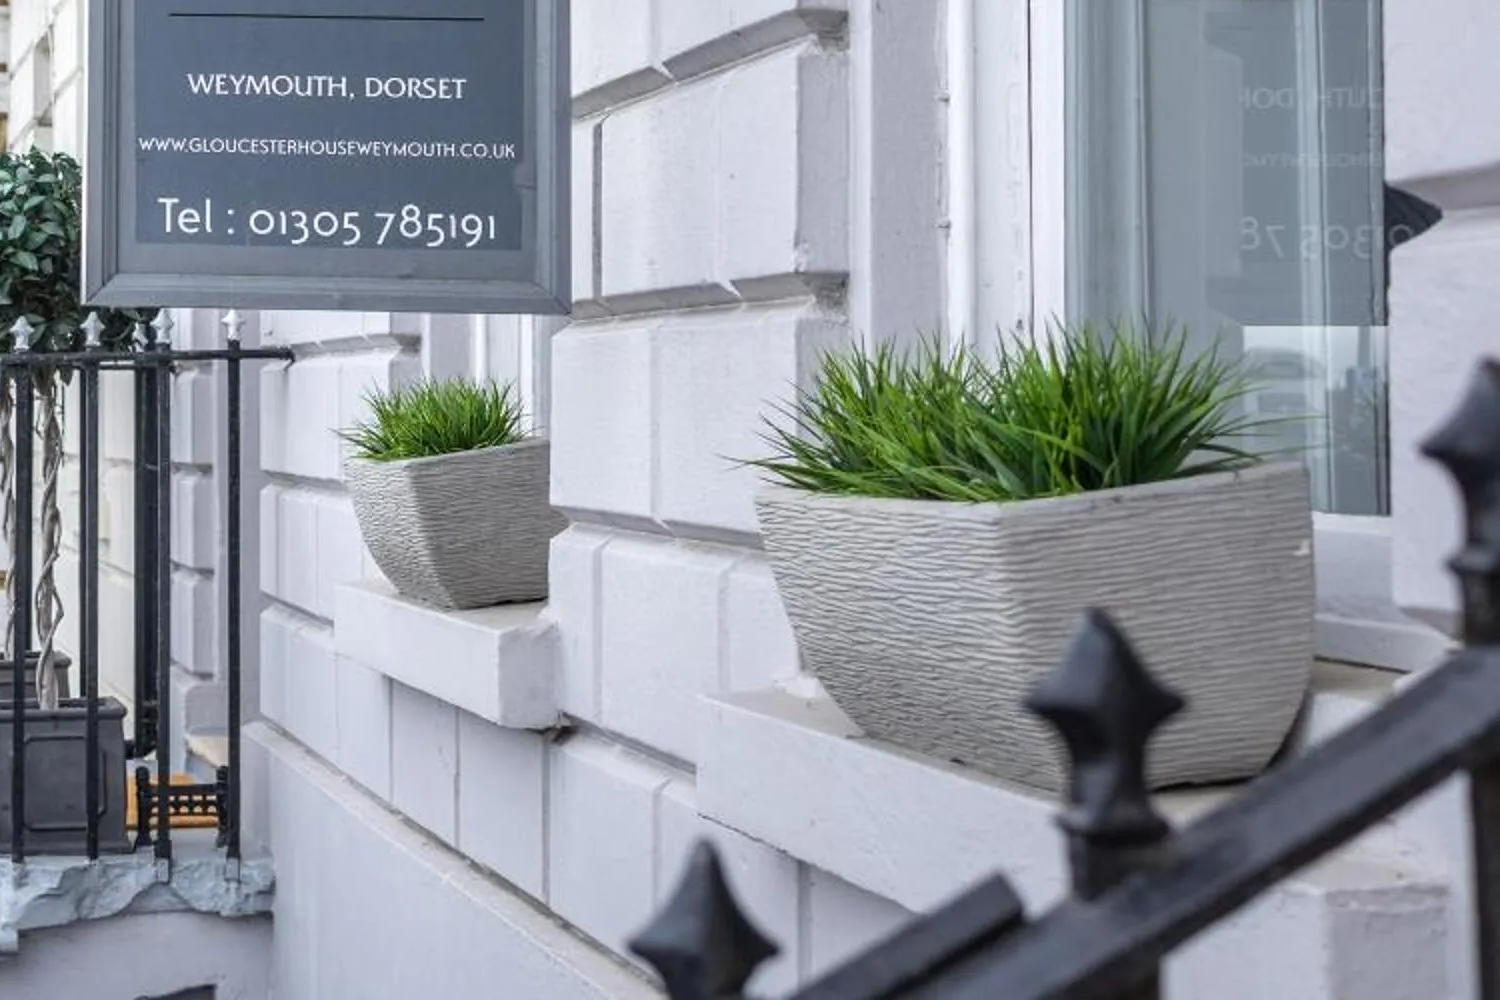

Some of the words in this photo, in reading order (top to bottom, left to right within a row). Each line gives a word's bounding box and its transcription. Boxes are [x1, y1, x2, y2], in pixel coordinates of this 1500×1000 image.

[365, 77, 467, 99] DORSET
[138, 137, 516, 159] WWW.GLOUCESTERHOUSEWEYMOUTH.CO.UK
[157, 197, 212, 234] Tel
[249, 209, 361, 245] 01305
[374, 203, 498, 247] 785191
